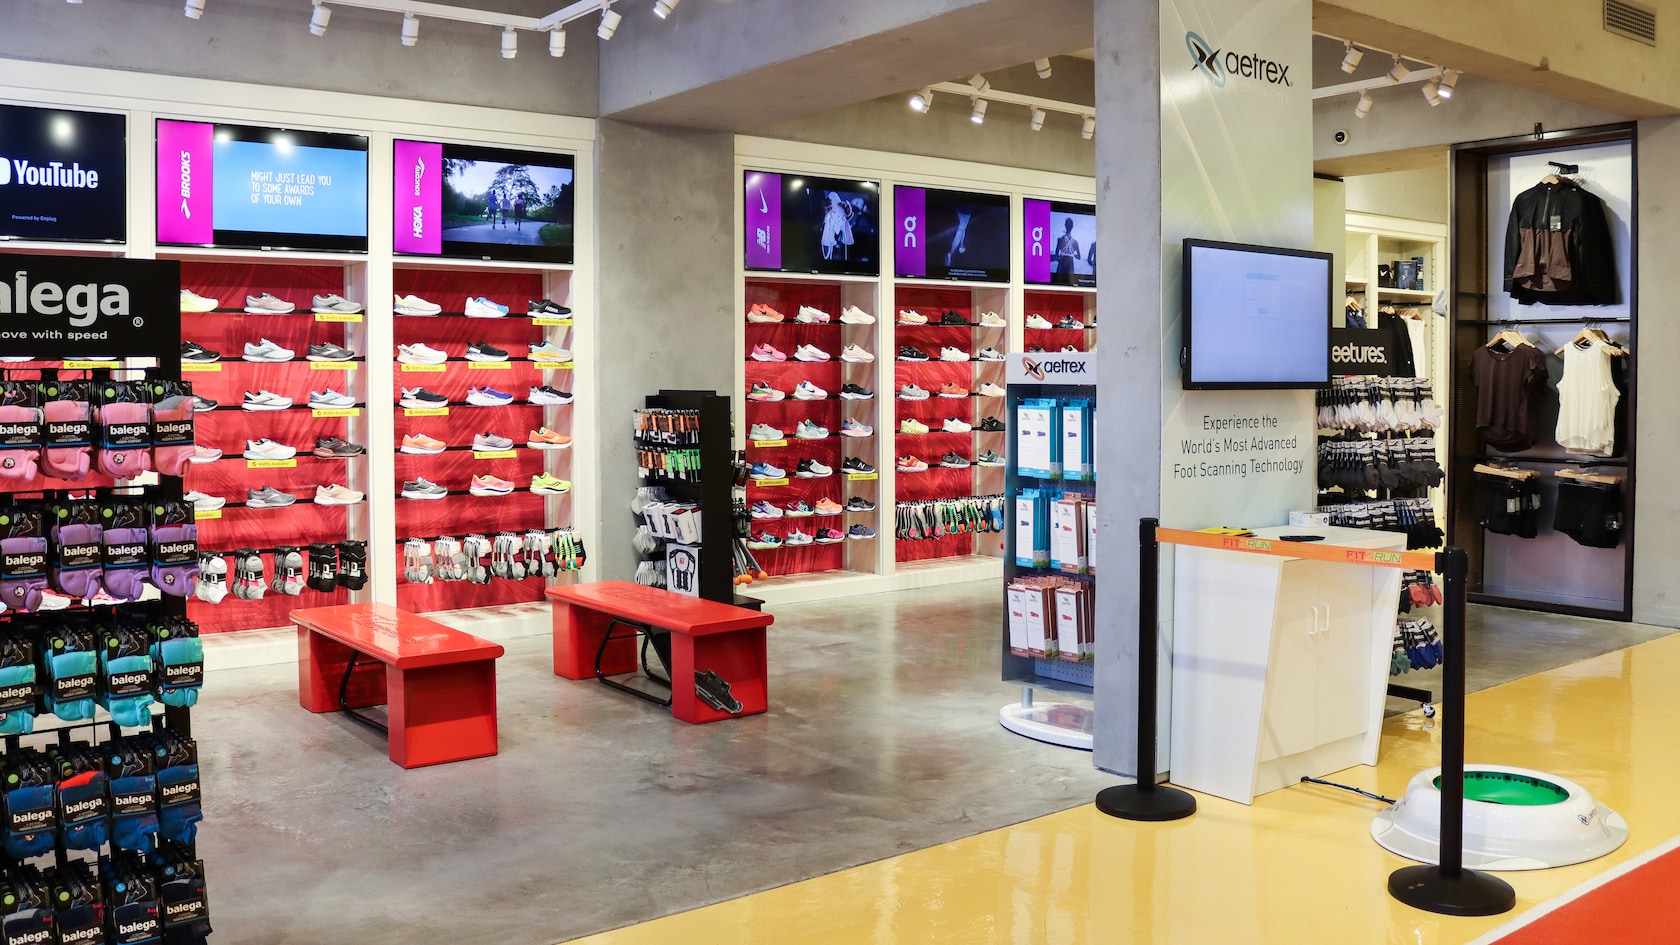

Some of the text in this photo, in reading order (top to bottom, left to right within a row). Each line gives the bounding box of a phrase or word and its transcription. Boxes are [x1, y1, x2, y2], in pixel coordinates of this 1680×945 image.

[1226, 52, 1289, 86] aetrex
[14, 160, 98, 189] YouTube
[181, 151, 190, 198] BROOKS
[251, 171, 332, 186] MIGHT JUST LEAD YOU
[251, 182, 314, 196] TO SOME AWARDS
[251, 194, 302, 206] OF YOUR OWN
[413, 206, 422, 238] HOKA
[32, 329, 62, 340] with
[68, 330, 108, 342] speed
[1044, 359, 1086, 374] aetrex
[0, 424, 38, 436] balega
[50, 423, 87, 434] balega
[110, 424, 146, 436] balega
[156, 422, 192, 435] balega
[1203, 414, 1278, 434] Experience the
[1181, 436, 1297, 454] World's Most Advanced
[1174, 458, 1304, 479] Foot Scanning Technology
[64, 545, 98, 558] balega
[108, 545, 144, 557] balega
[160, 544, 194, 556] balega
[6, 554, 43, 567] balega
[167, 665, 200, 677] balega
[58, 676, 93, 690] balega
[112, 674, 146, 686] balega
[163, 782, 197, 797] balega
[66, 798, 102, 814] balega
[116, 794, 152, 806] balega
[13, 808, 52, 824] balega
[166, 900, 202, 914] balega
[120, 919, 156, 934] balega
[9, 930, 50, 945] balega
[62, 927, 100, 943] balega
